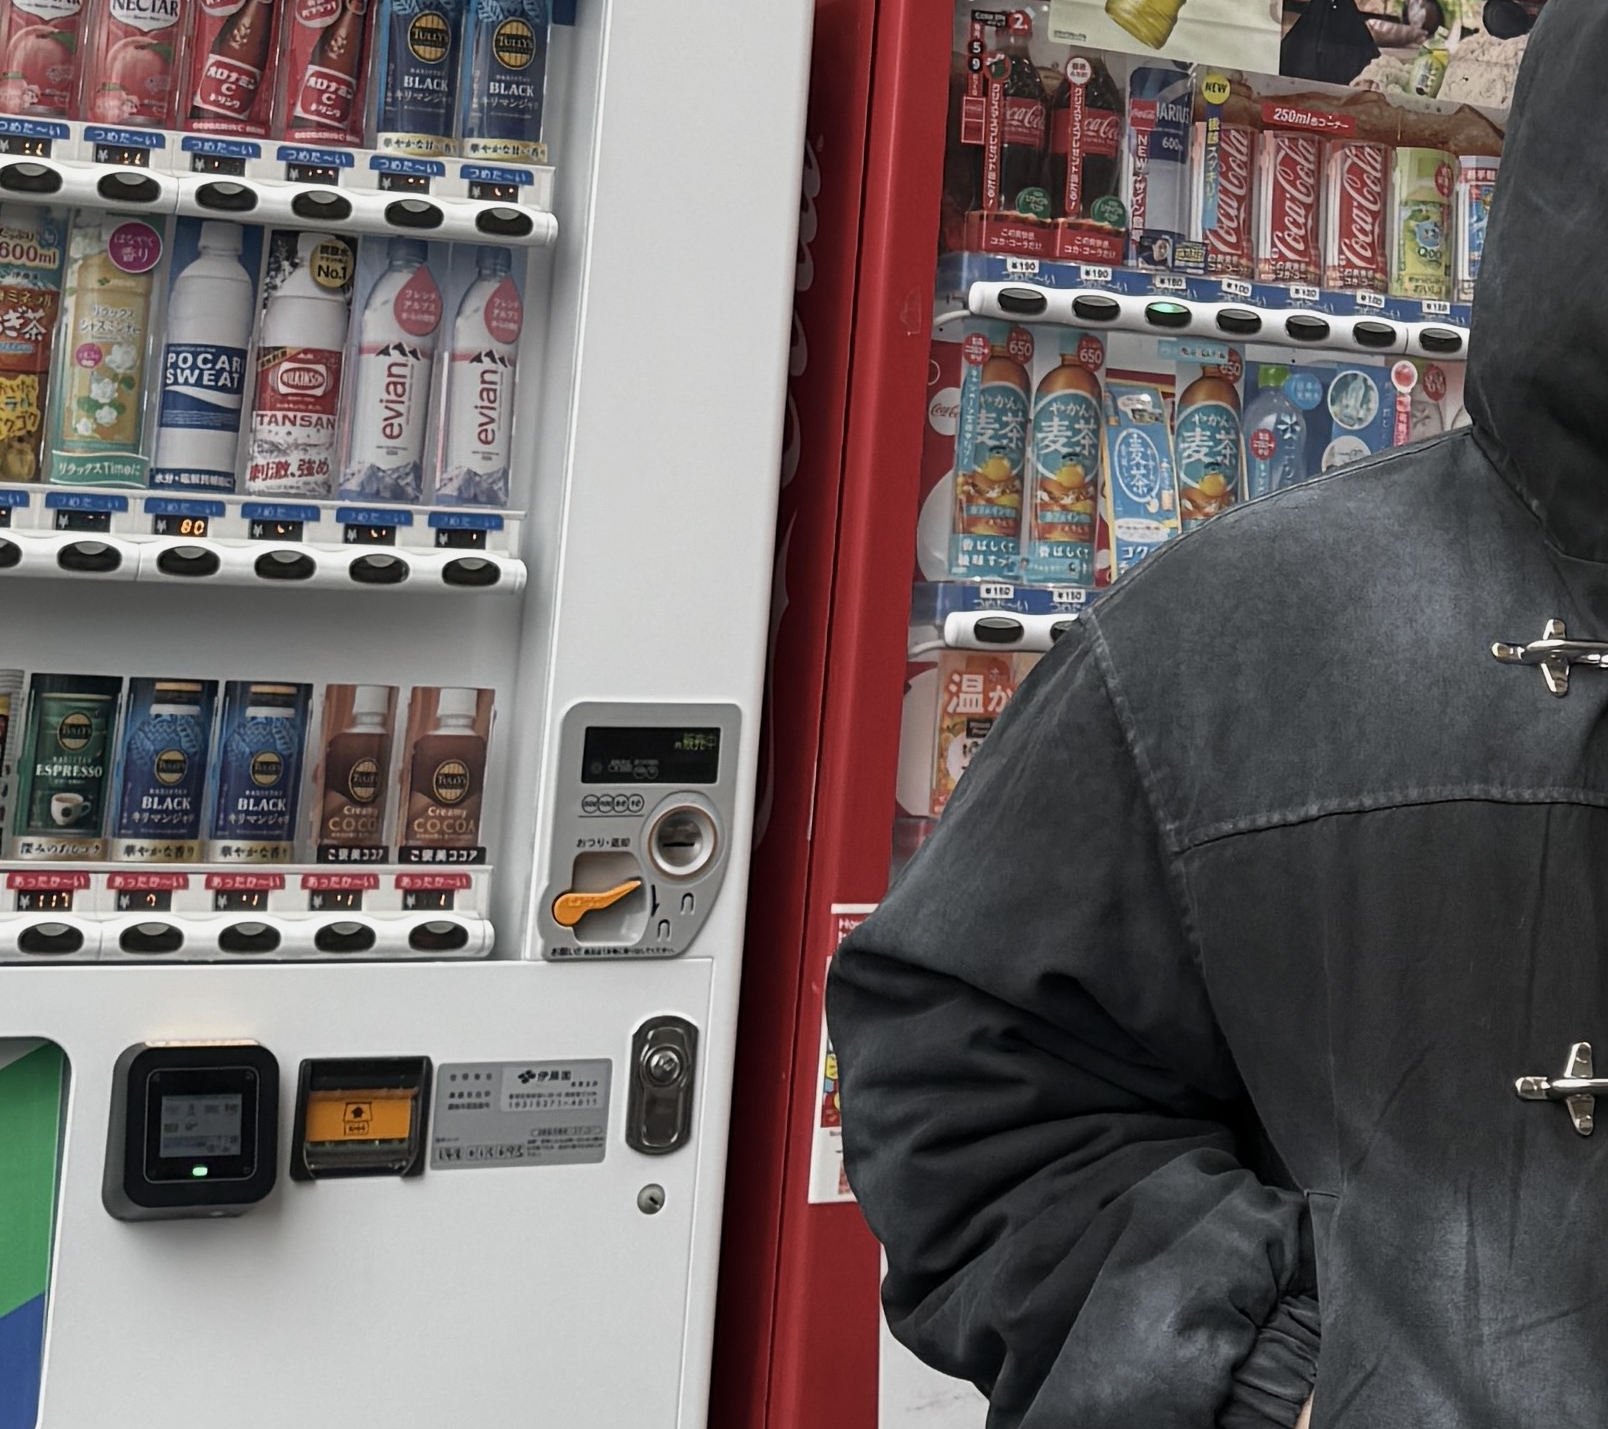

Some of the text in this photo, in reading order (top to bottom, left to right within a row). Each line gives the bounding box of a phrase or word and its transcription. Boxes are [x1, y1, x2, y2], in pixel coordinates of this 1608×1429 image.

[207, 65, 259, 89] オロナミン
[403, 74, 449, 92] BLACK
[221, 82, 235, 95] C
[306, 75, 354, 99] オロナミン
[488, 80, 535, 98] BLACK
[1204, 80, 1229, 93] NEW
[209, 93, 241, 109] ドリンク
[322, 92, 335, 106] C
[310, 103, 342, 119] ドリンク
[1273, 135, 1317, 263] Coca-Cola
[1341, 143, 1383, 269] Coca-Cola
[121, 248, 149, 263] 香り
[316, 263, 348, 281] No.1
[0, 306, 48, 341] ぎ茶
[1009, 340, 1032, 356] 650
[1079, 348, 1102, 364] 650
[165, 367, 240, 389] SWEAT
[379, 357, 408, 441] evian
[474, 365, 500, 447] evian
[256, 412, 336, 431] TANSAN
[975, 409, 1026, 450] 麦茶
[1036, 415, 1098, 455] 麦茶
[1180, 426, 1238, 466] 麦茶
[1128, 433, 1151, 495] 麦茶
[179, 519, 205, 535] 80
[35, 764, 103, 778] ESPRESSO
[141, 796, 192, 811] BLACK
[237, 797, 287, 812] BLACK
[413, 818, 477, 834] COCOA
